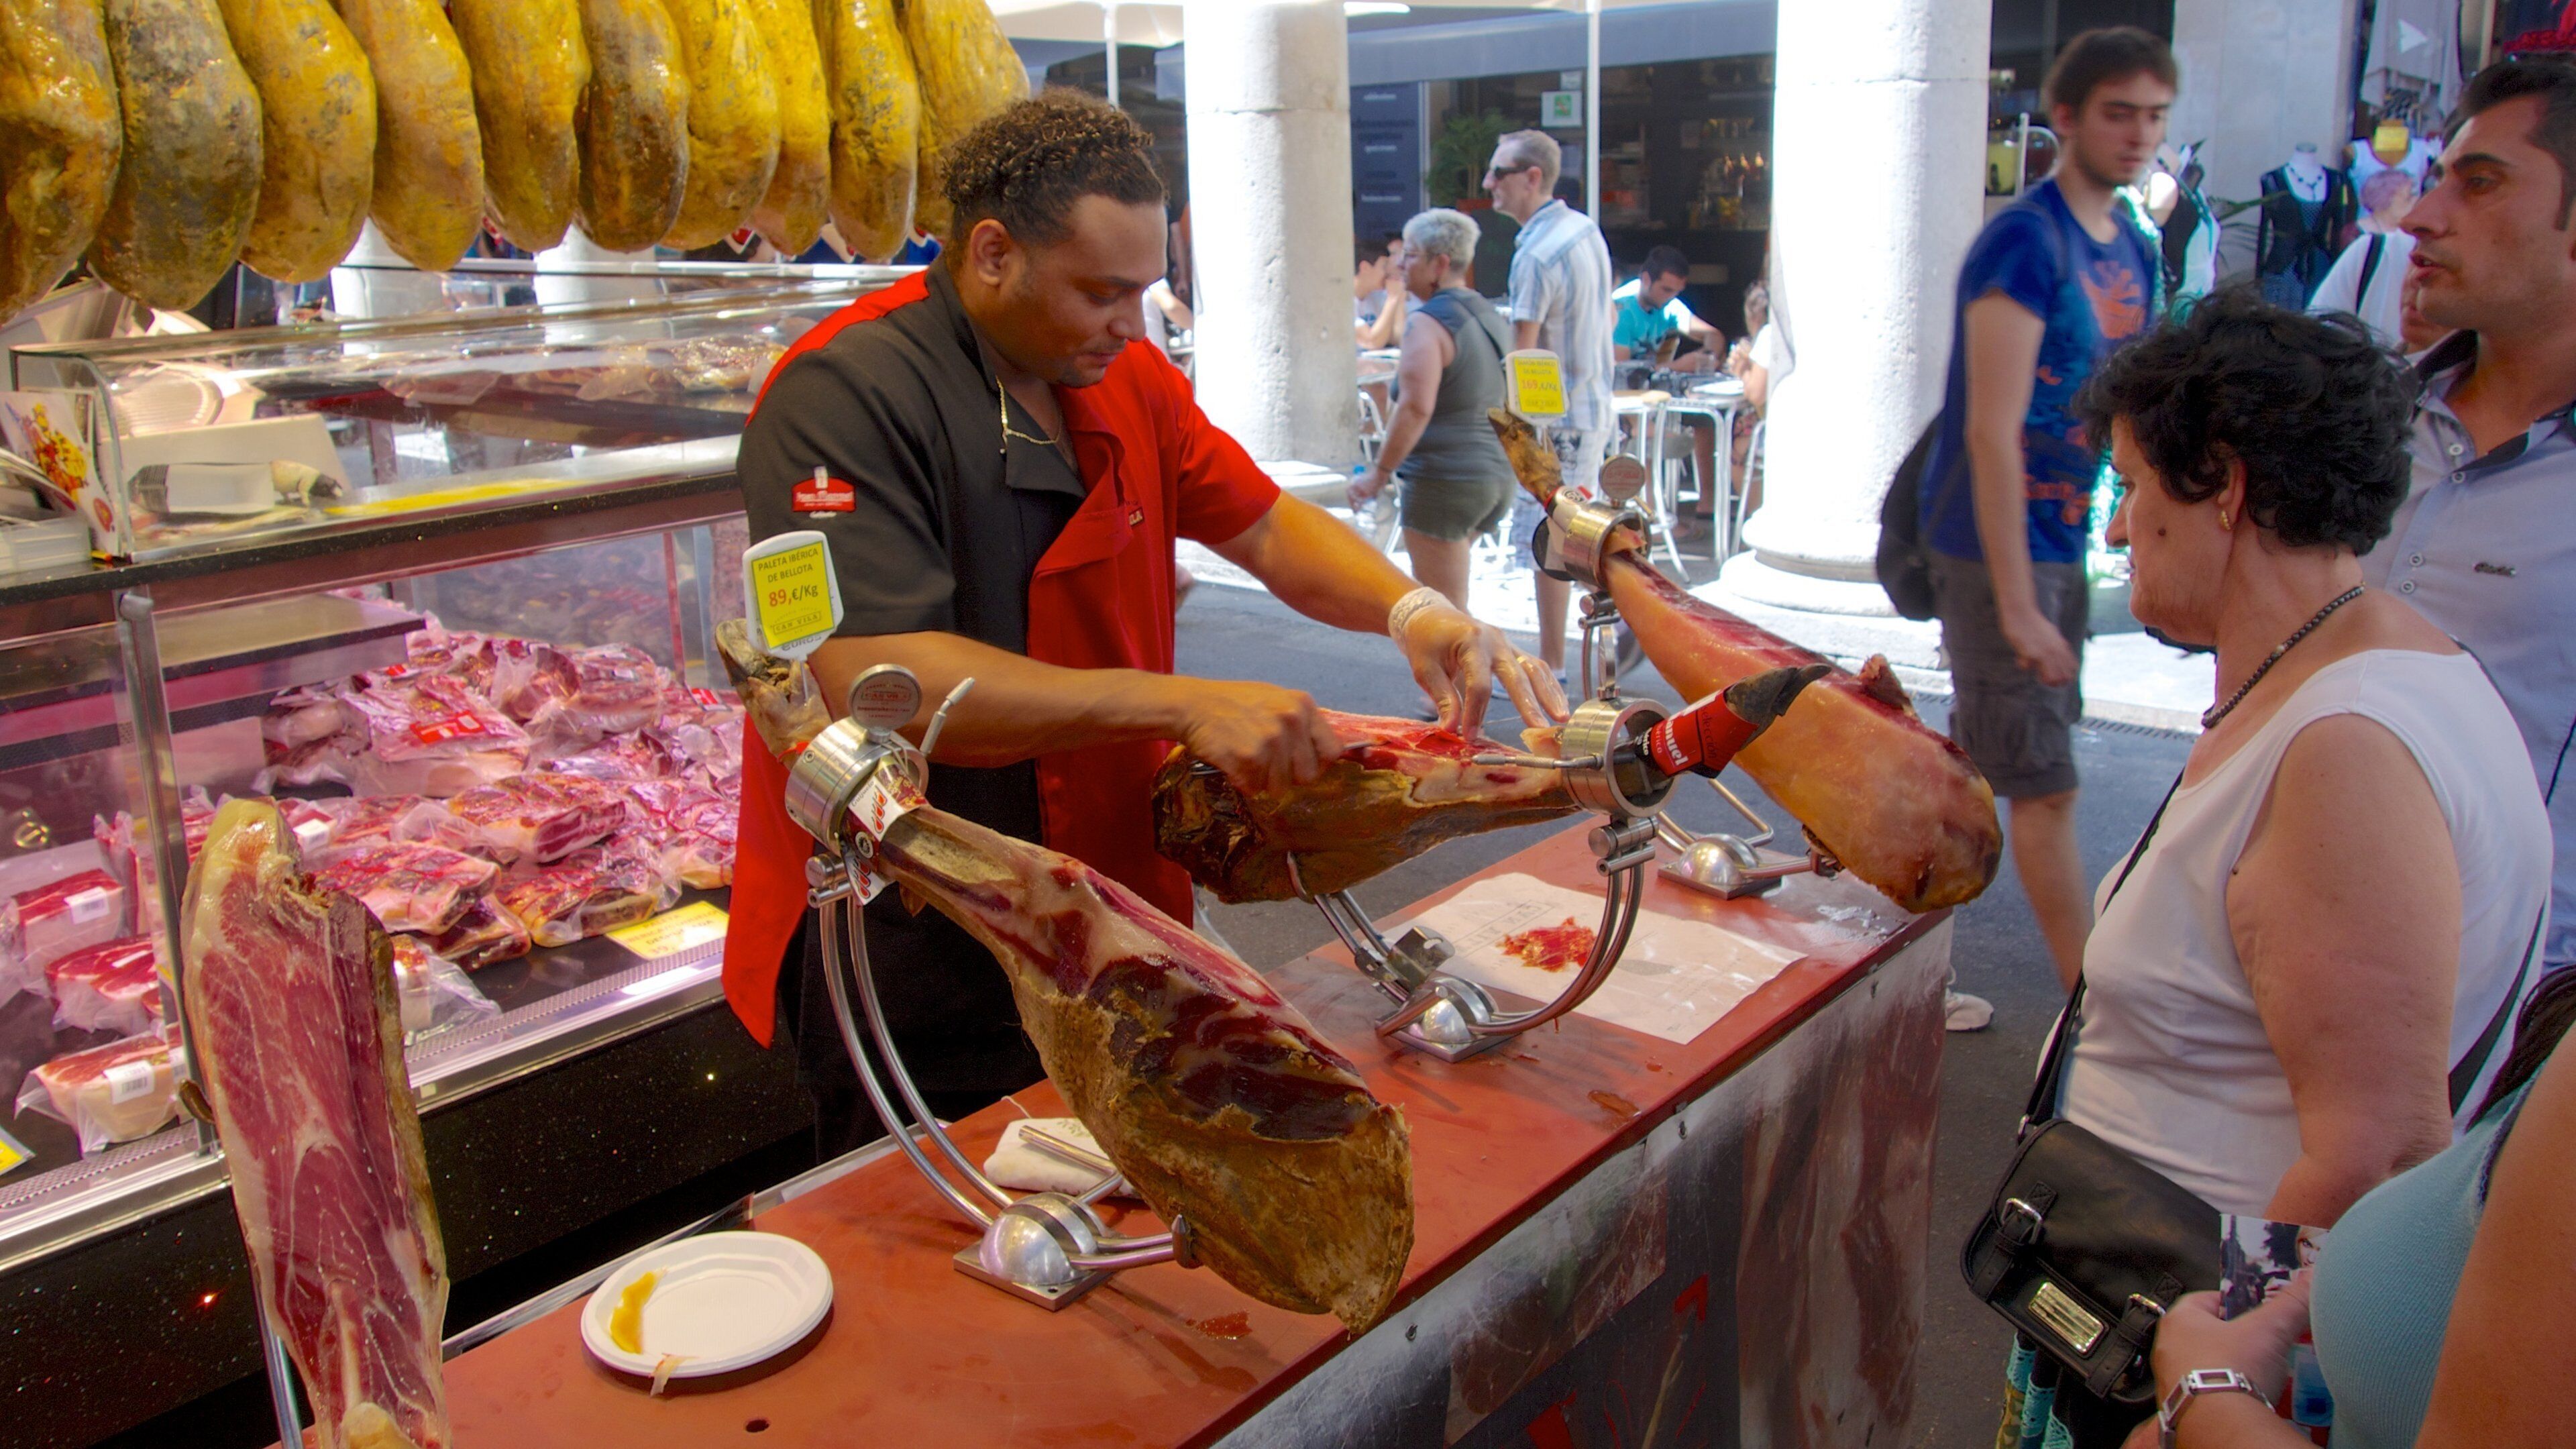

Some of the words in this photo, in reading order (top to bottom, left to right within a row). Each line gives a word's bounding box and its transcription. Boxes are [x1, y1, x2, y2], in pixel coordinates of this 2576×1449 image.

[758, 557, 788, 572] PALETA
[788, 547, 818, 563] IBÉRICA
[767, 572, 778, 583] DE
[780, 564, 813, 580] BELLOTA
[1665, 716, 1688, 766] anuel
